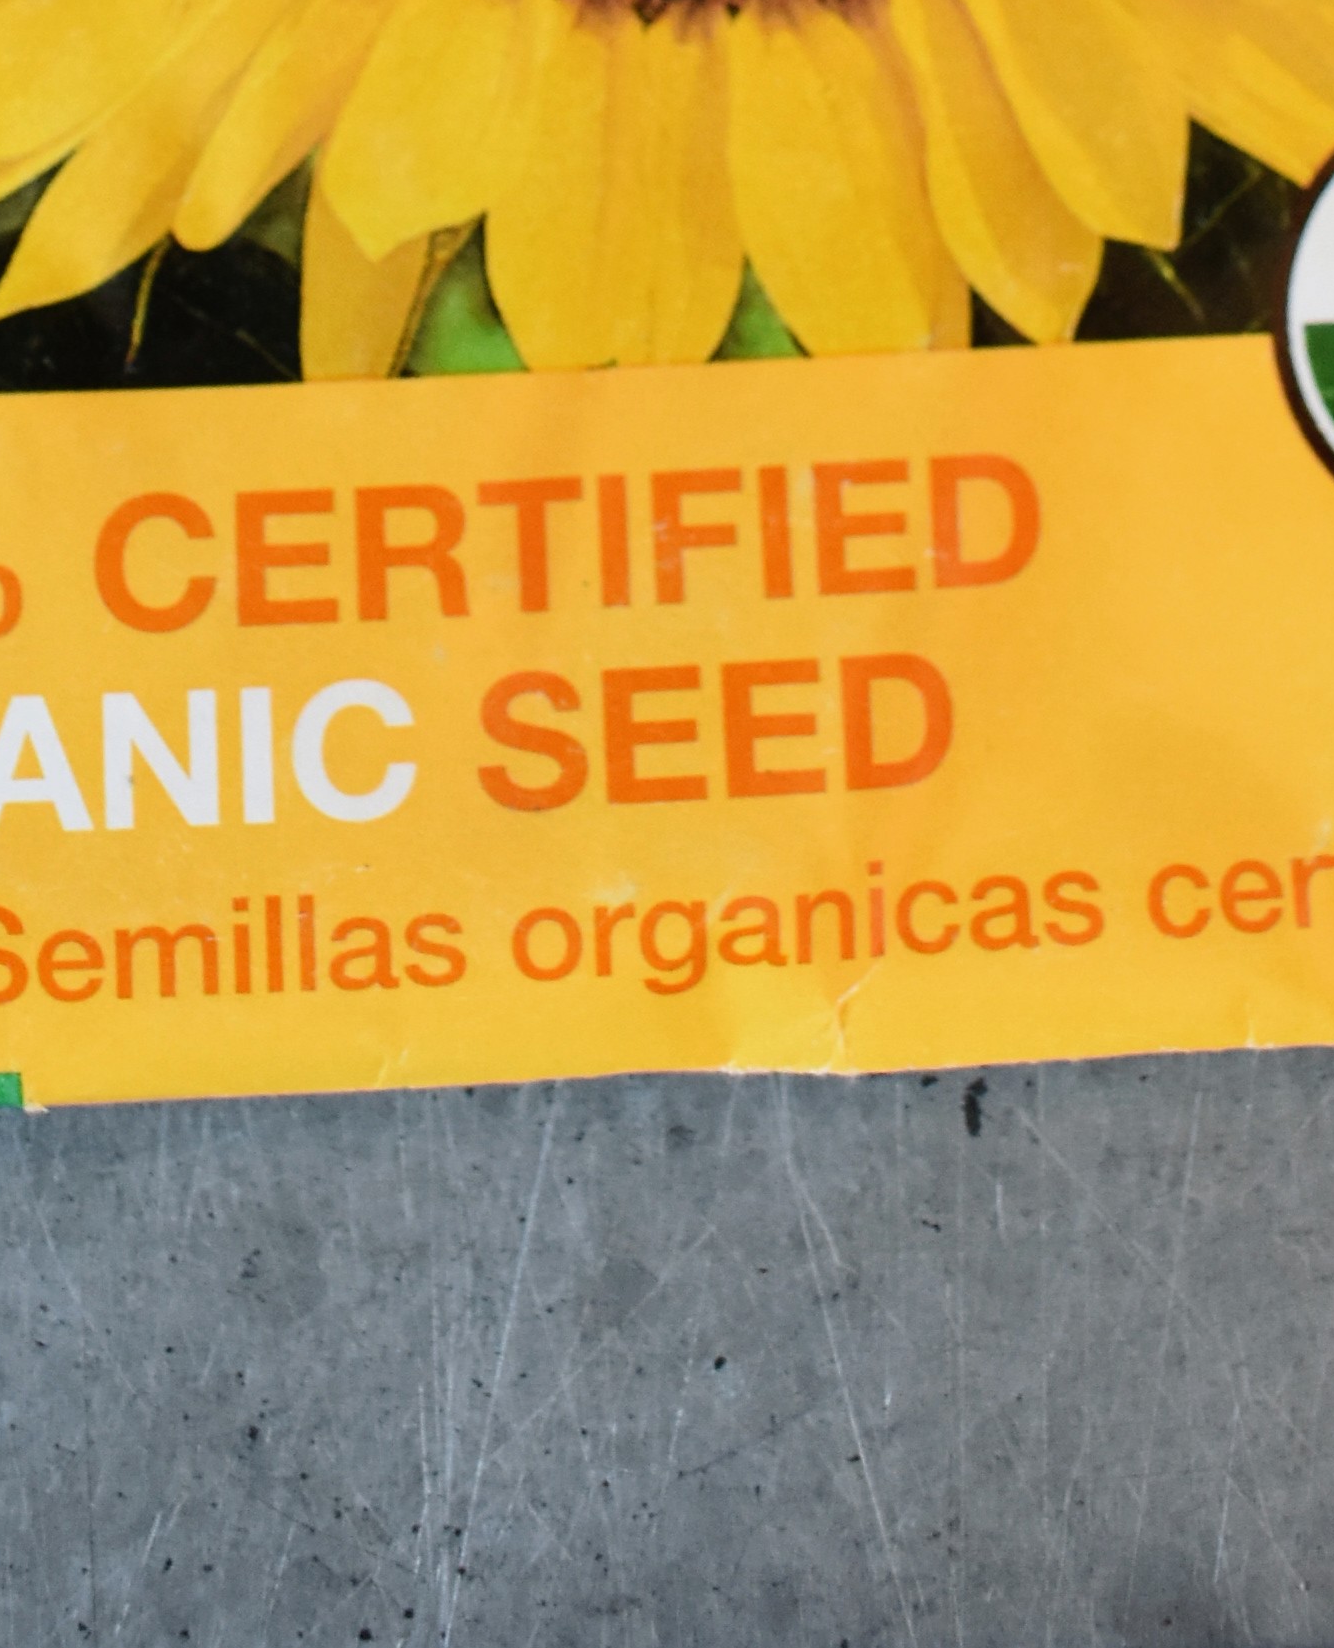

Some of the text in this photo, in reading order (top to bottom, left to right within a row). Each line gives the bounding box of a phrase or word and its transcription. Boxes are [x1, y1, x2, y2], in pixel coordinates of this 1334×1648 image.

[93, 453, 1043, 635] CERTIFIED
[477, 651, 957, 815] SEED
[511, 859, 1107, 997] organicas
